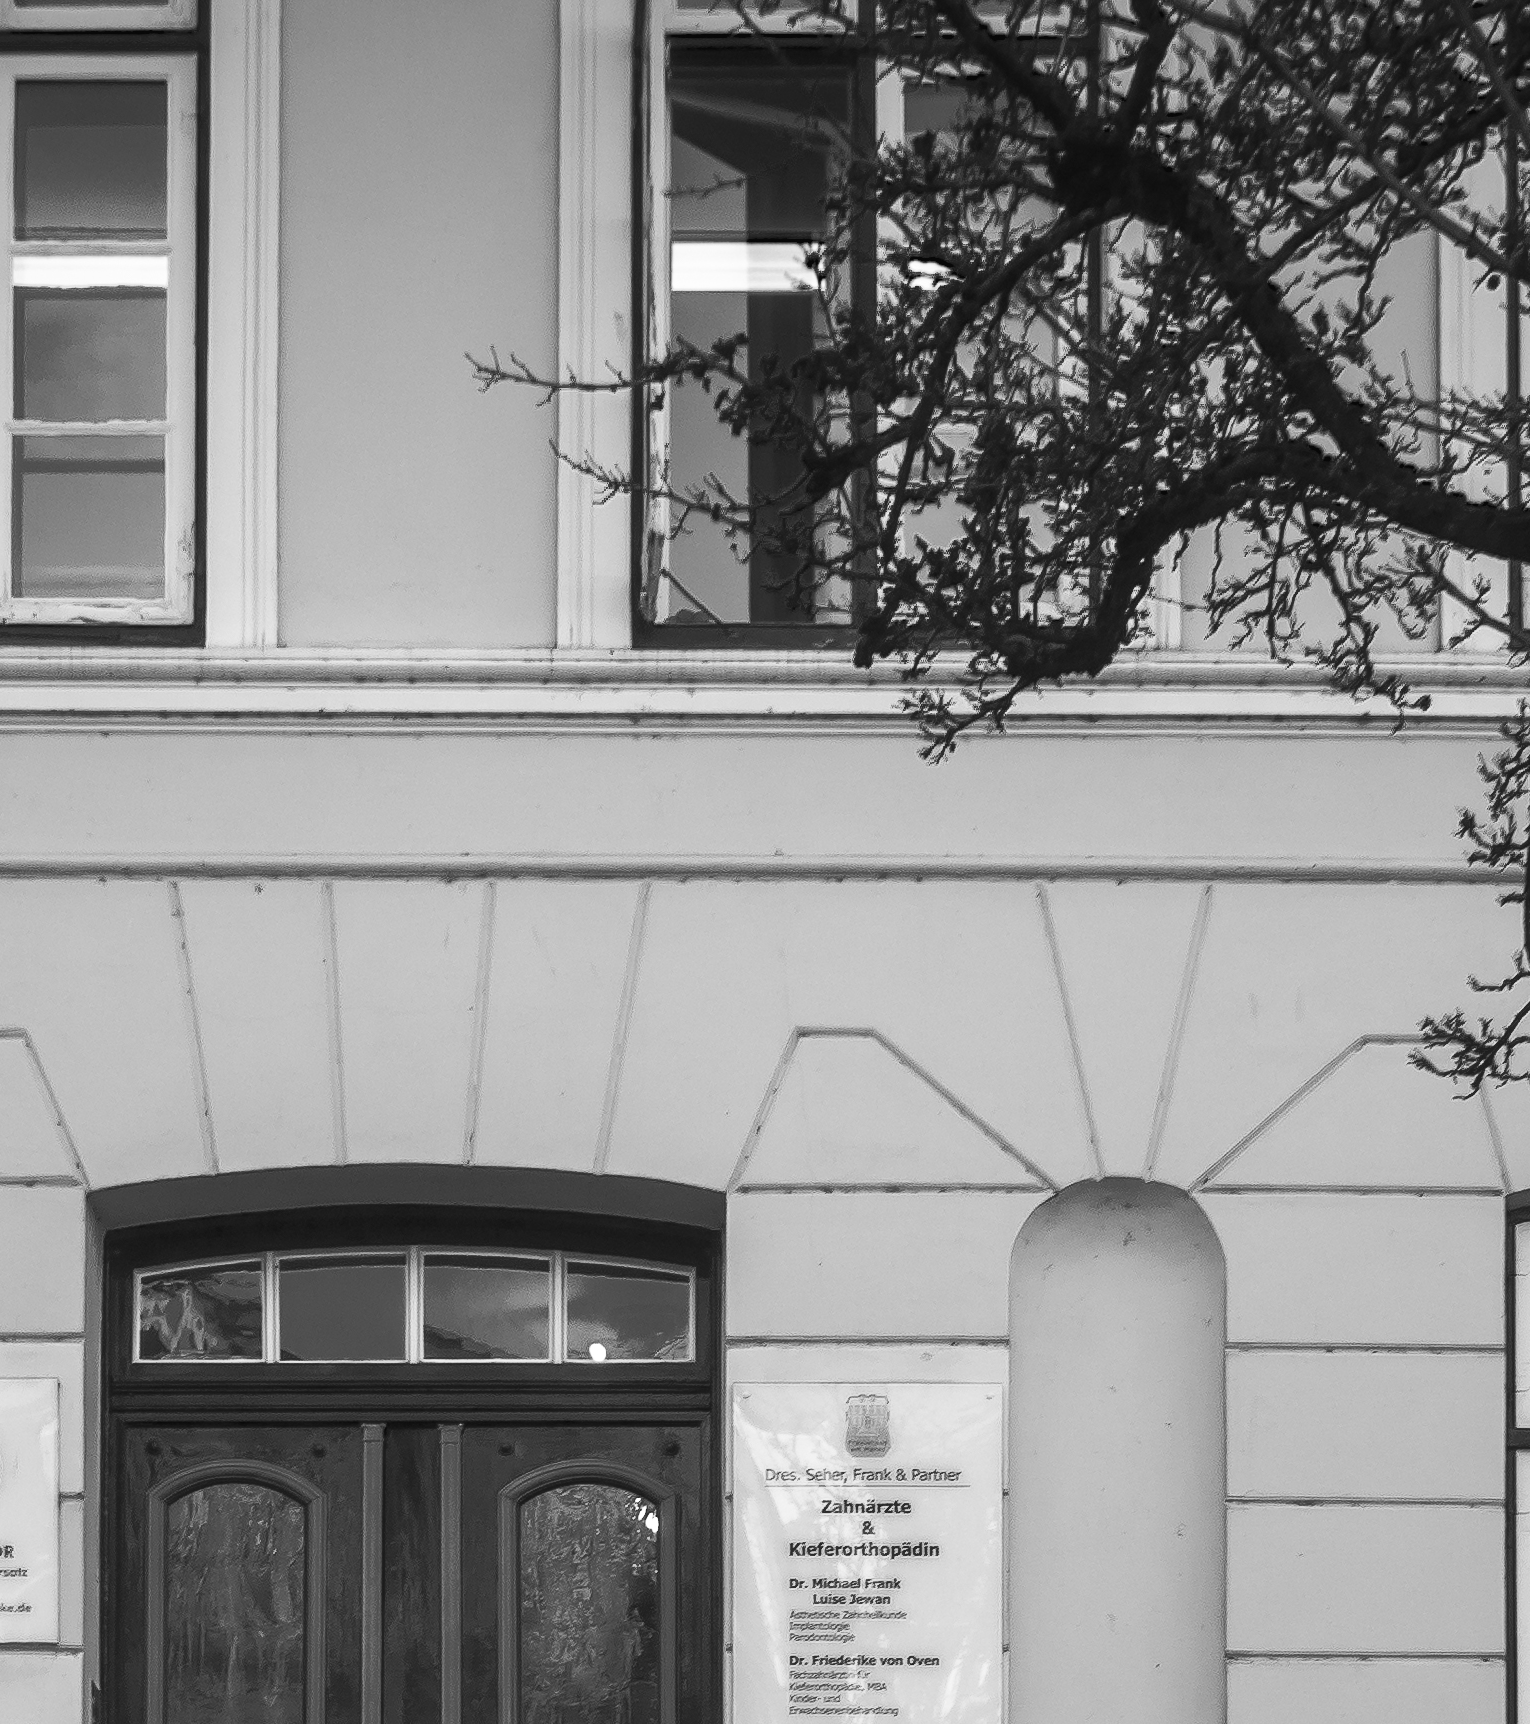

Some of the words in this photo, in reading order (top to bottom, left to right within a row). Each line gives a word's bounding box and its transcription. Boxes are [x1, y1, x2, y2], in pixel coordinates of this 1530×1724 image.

[765, 1468, 801, 1482] Dres.
[805, 1468, 848, 1484] Seher,
[853, 1468, 892, 1482] Frank
[896, 1468, 908, 1482] &
[911, 1468, 962, 1482] Partner
[820, 1499, 912, 1515] Zahnärzte
[861, 1520, 876, 1536] &
[788, 1541, 941, 1560] Kieferorthopädin
[788, 1578, 809, 1590] Dr.
[812, 1577, 861, 1590] Michael
[864, 1578, 902, 1590] Frank
[812, 1594, 847, 1606] Luise
[850, 1594, 892, 1606] Jewan
[788, 1655, 809, 1667] Dr.
[812, 1654, 877, 1667] Friederike
[880, 1657, 904, 1667] von
[906, 1655, 940, 1667] Oven
